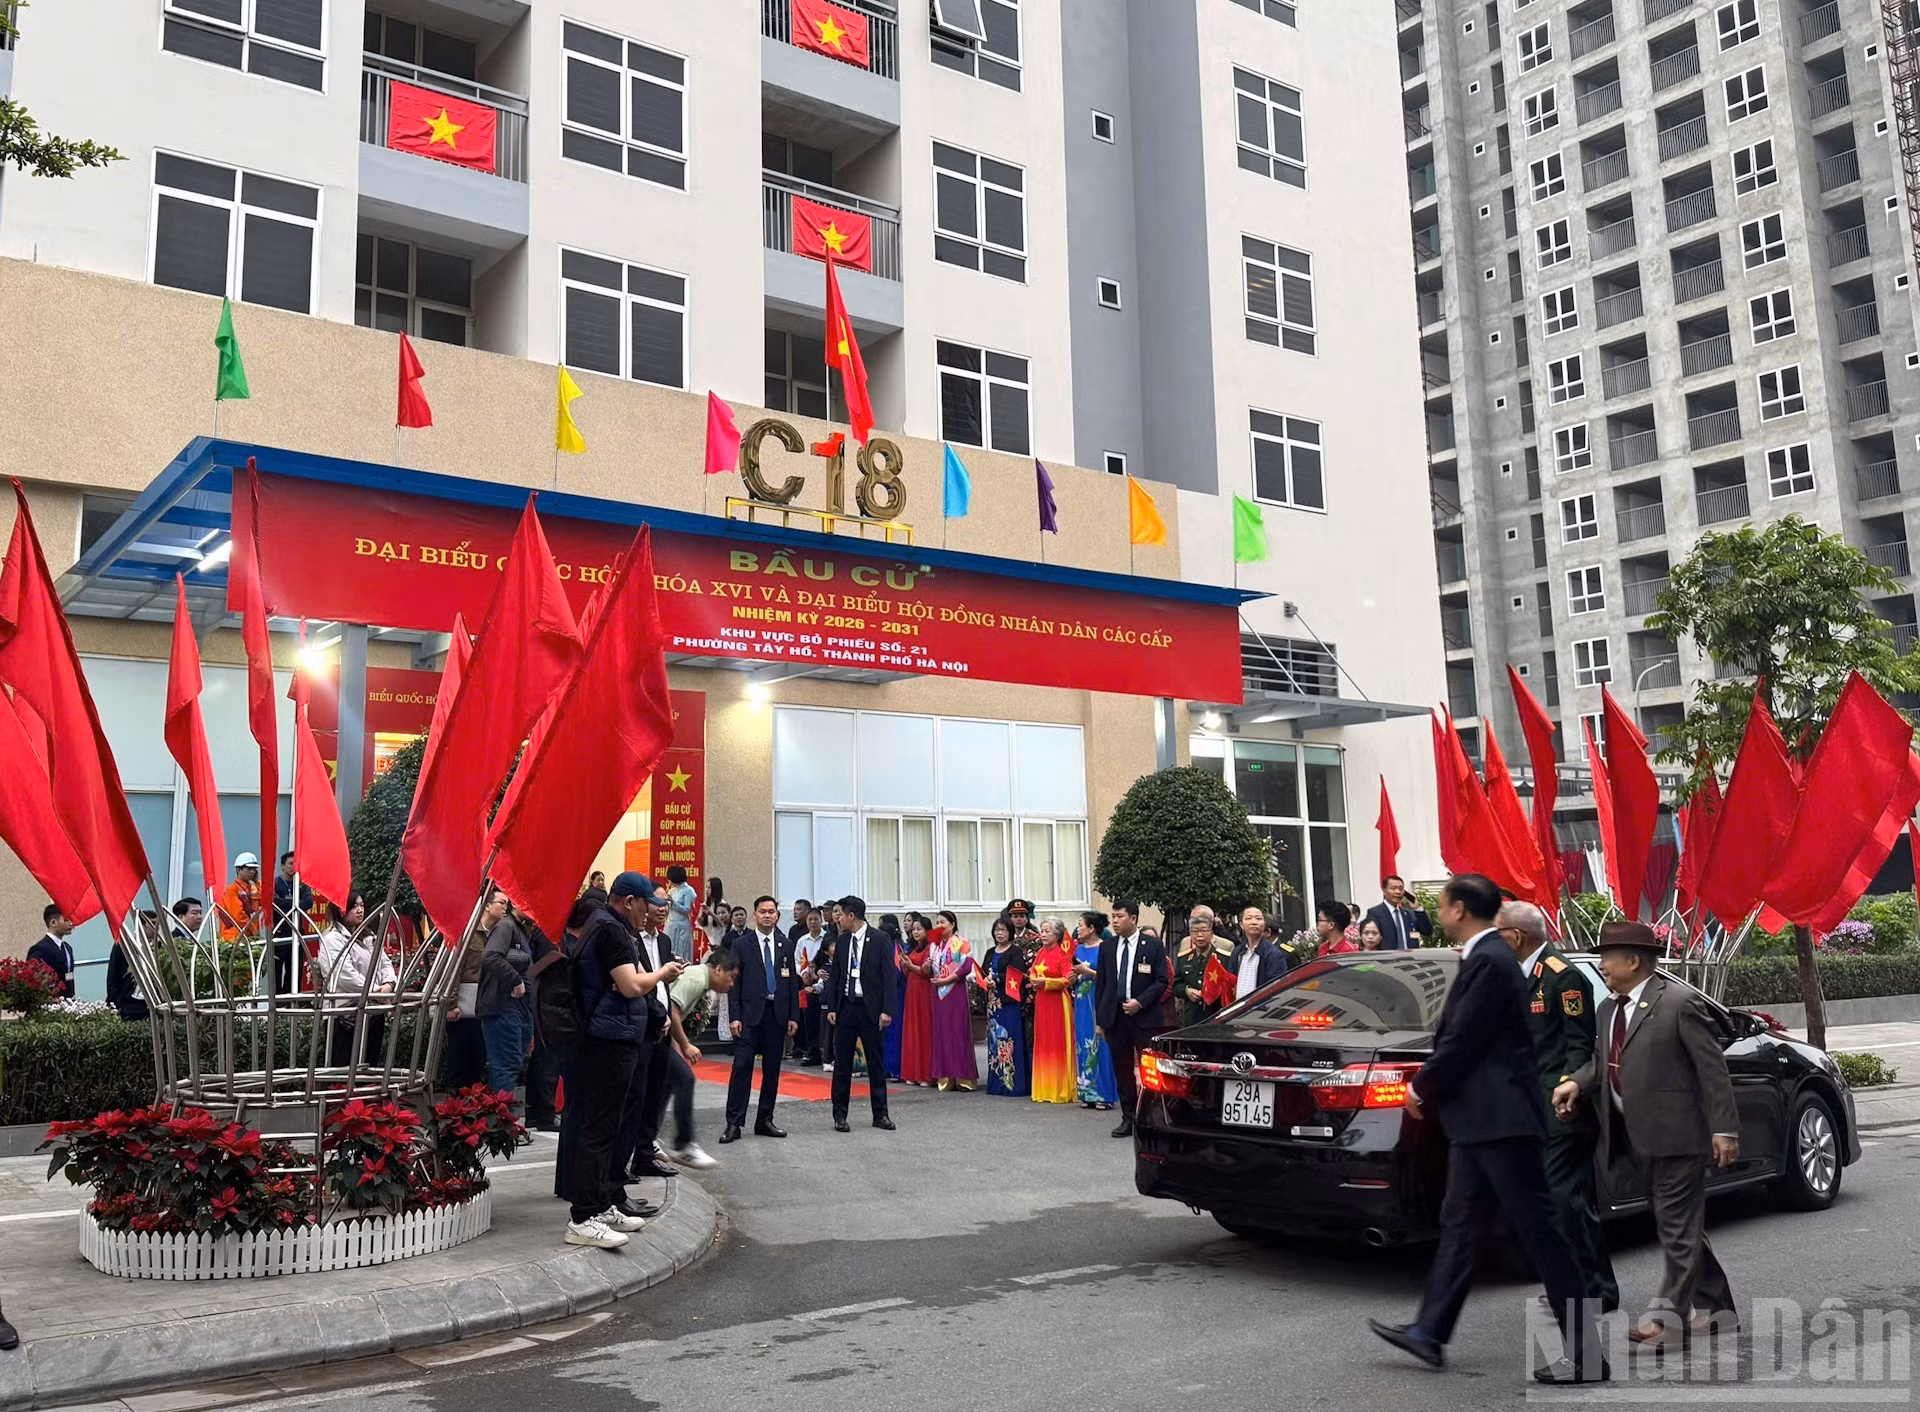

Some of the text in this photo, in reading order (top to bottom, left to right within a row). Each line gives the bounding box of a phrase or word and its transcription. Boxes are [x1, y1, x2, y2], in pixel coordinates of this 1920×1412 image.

[739, 418, 906, 520] C18
[730, 548, 835, 581] BẦU
[851, 562, 919, 591] CỬ
[355, 538, 410, 562] ĐẠI
[420, 541, 488, 570] BIỂU
[653, 572, 703, 594] HÓA
[710, 581, 752, 600] XVI
[760, 584, 791, 603] VÀ
[798, 590, 836, 610] ĐẠI
[842, 590, 890, 615] BIỂU
[897, 601, 934, 621] HỘI
[940, 602, 995, 628] ĐỒNG
[1000, 613, 1054, 635] NHÂN
[1059, 620, 1098, 640] DÂN
[1103, 625, 1136, 645] CÁC
[1140, 627, 1173, 648] CẤP
[732, 606, 792, 624] NHIỆM
[797, 610, 818, 625] KỲ
[824, 614, 865, 630] 2026
[881, 620, 919, 636] 2031
[673, 636, 748, 652] PHƯỜNG
[752, 641, 785, 654] TÂY
[822, 648, 876, 663] THÀNH
[879, 653, 912, 666] PHỐ
[917, 656, 938, 669] HÀ
[942, 659, 969, 673] NỘI
[720, 627, 928, 656] KHU VỰC BỎ PHIẾU SỐ: 21
[369, 688, 393, 702] BIỂU
[395, 691, 423, 704] QUỐC
[1235, 1082, 1260, 1103] 29A
[1224, 1104, 1271, 1125] 951.45
